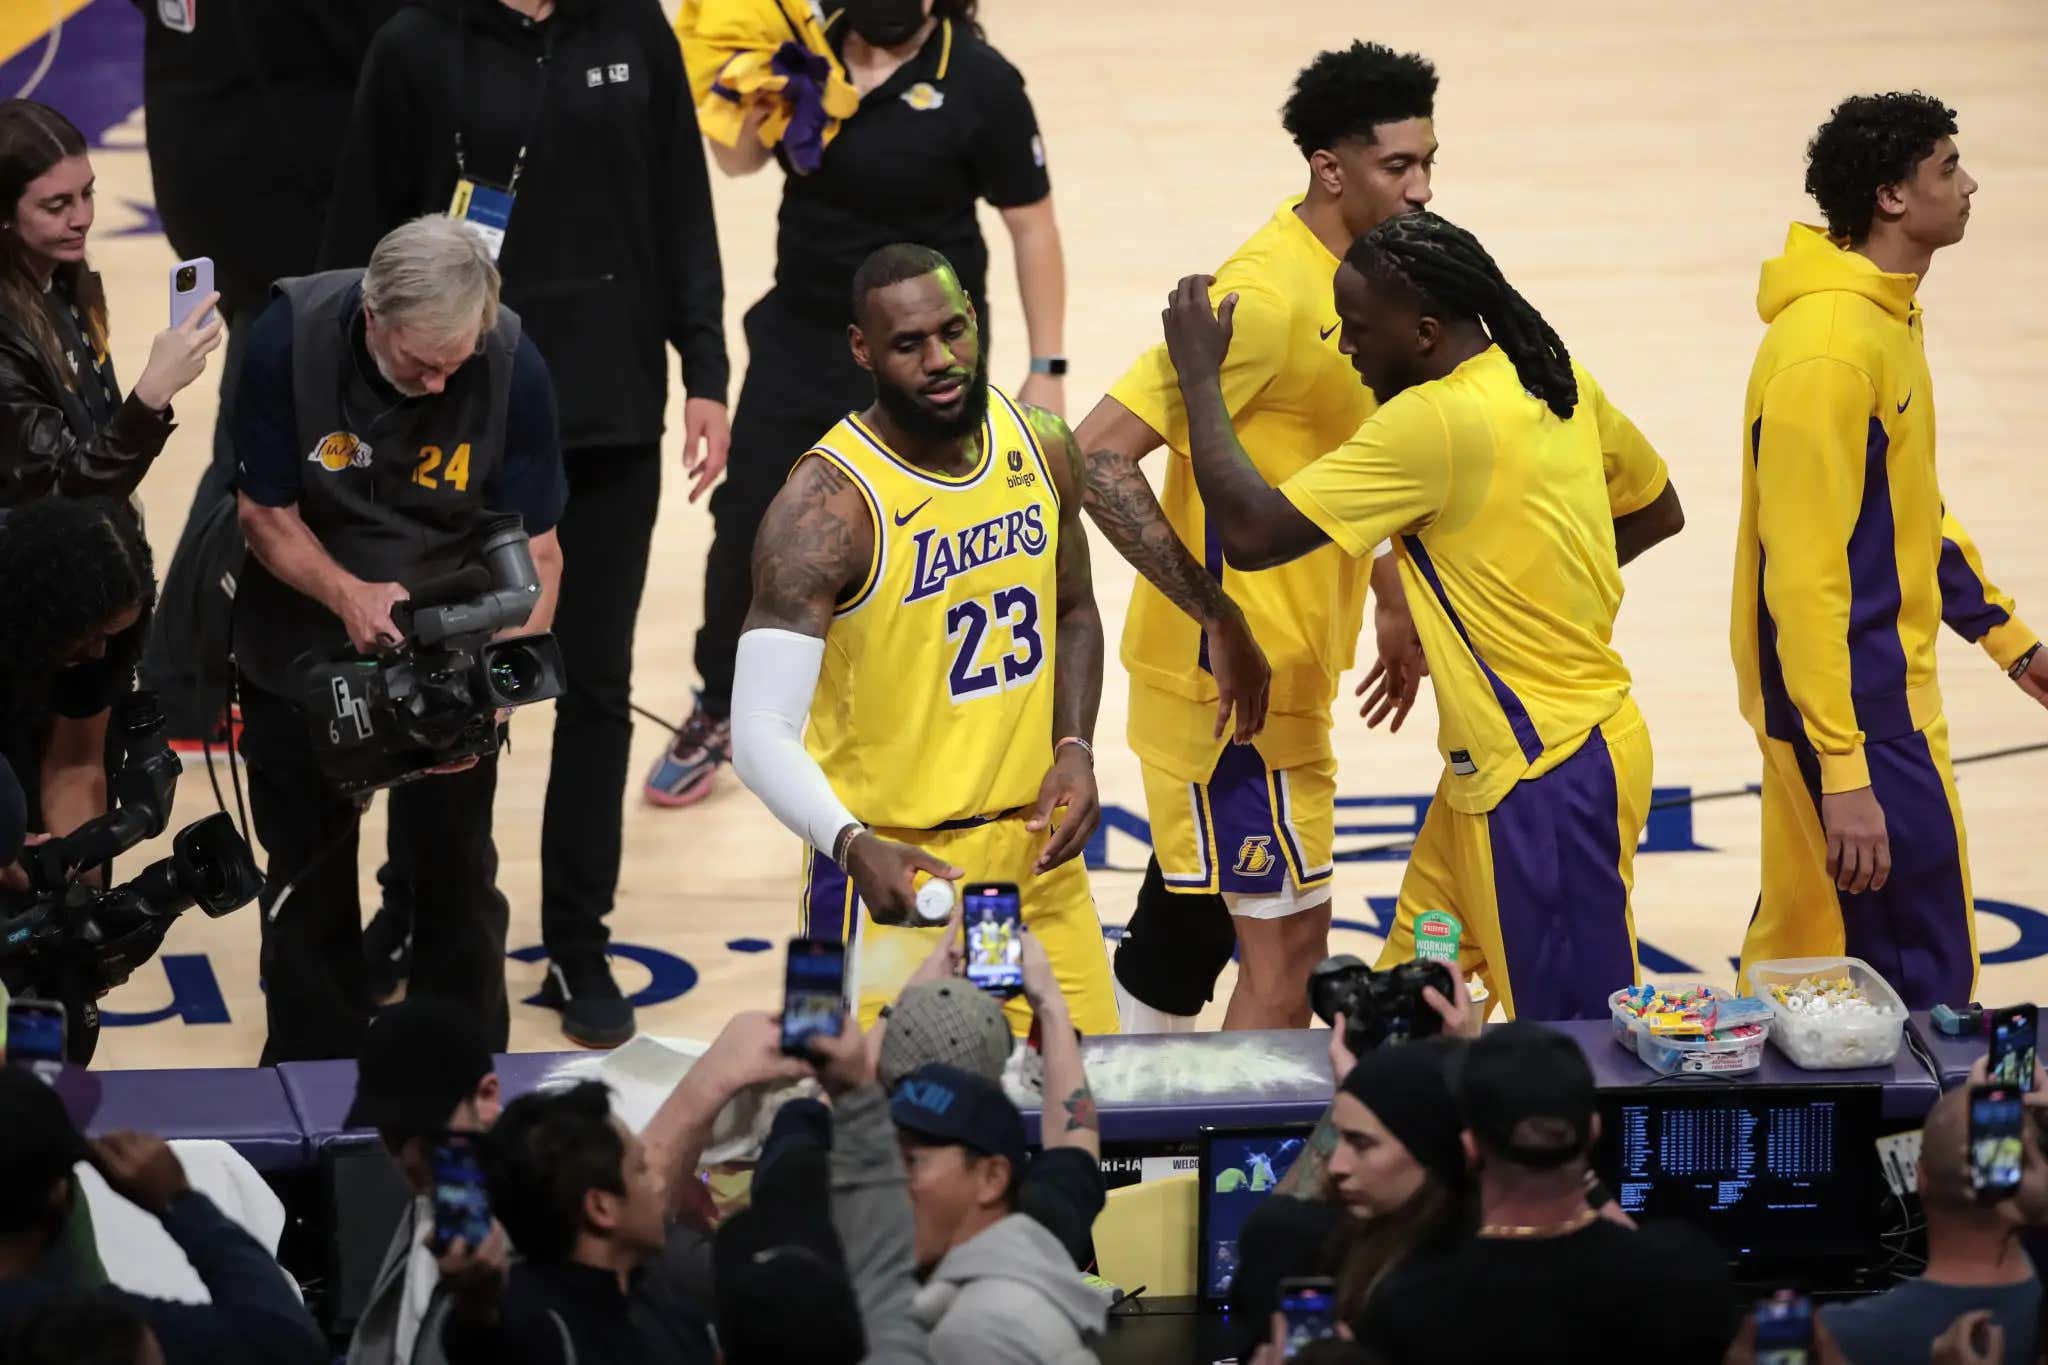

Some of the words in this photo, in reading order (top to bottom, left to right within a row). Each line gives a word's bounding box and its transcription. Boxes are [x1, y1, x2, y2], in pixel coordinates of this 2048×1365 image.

[411, 443, 471, 491] 24
[1006, 473, 1035, 488] bibigo
[903, 503, 1048, 604] LAKERS
[946, 585, 1044, 698] 23
[329, 719, 340, 744] 6
[1416, 939, 1455, 954] WORKING
